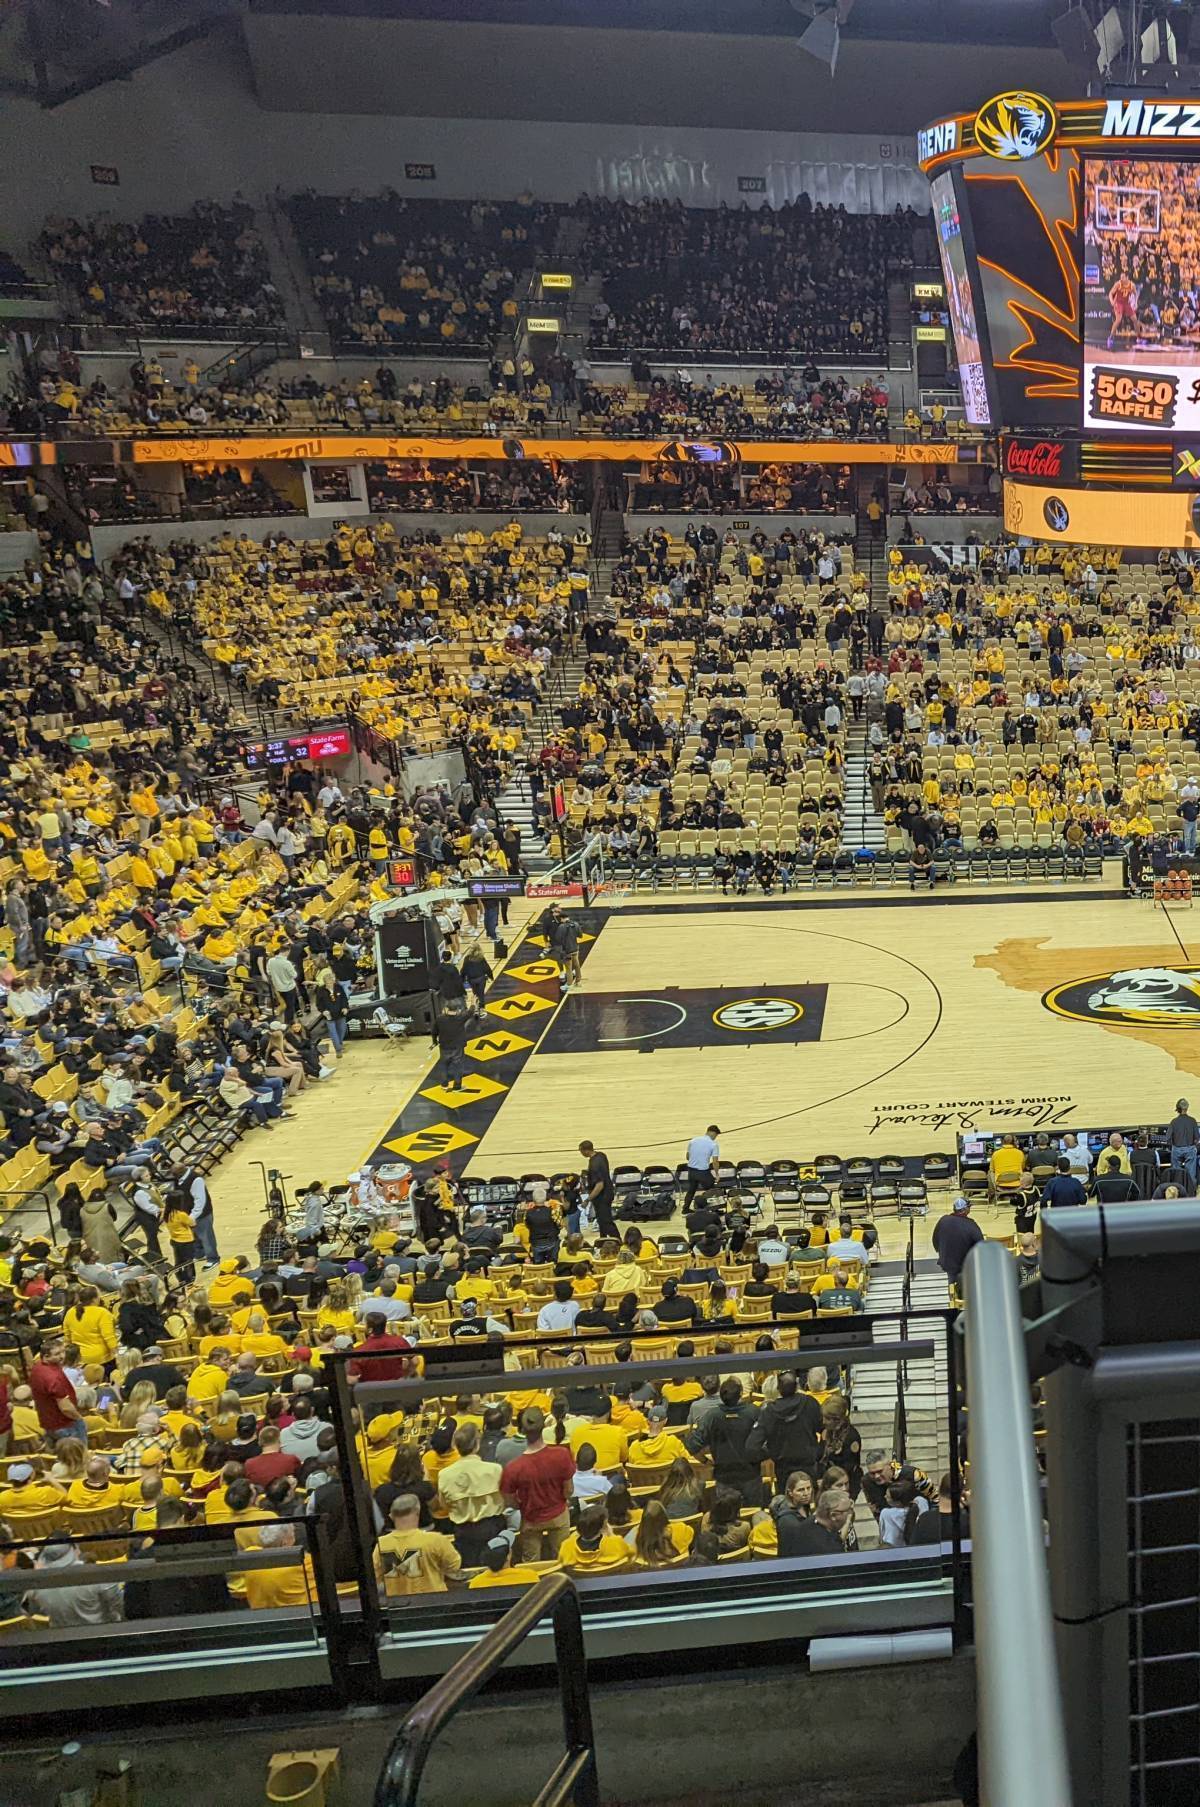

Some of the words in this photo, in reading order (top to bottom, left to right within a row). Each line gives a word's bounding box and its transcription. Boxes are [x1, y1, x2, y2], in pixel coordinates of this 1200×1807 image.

[1100, 398, 1164, 421] RAFFLE
[295, 747, 307, 756] 32
[393, 863, 411, 872] 3:37
[396, 872, 409, 882] 30
[936, 1098, 1015, 1109] STEWART
[1021, 1096, 1071, 1105] NORM
[872, 1103, 930, 1112] COURT
